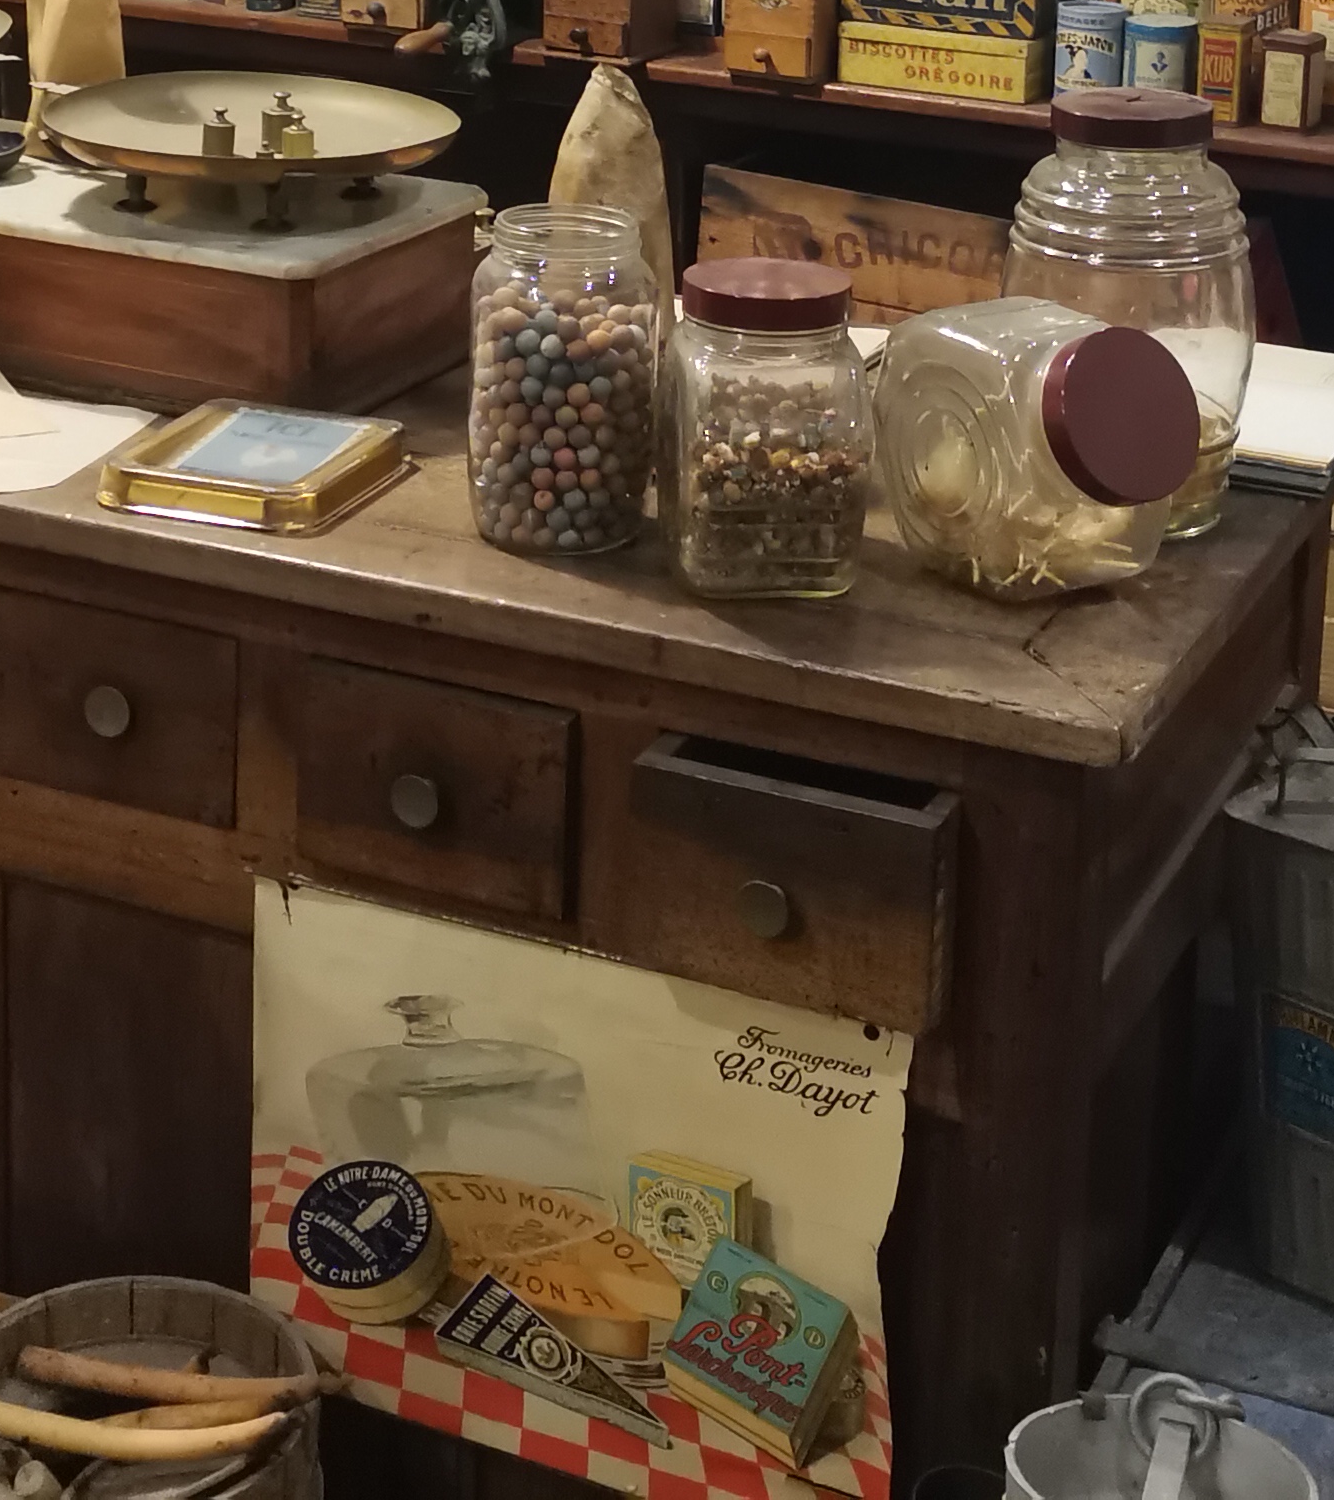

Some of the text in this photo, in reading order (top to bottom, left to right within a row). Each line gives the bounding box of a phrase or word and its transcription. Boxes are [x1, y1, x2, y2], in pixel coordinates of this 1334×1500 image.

[848, 39, 955, 65] BISCOTTES
[1204, 54, 1233, 84] KUB
[904, 63, 1014, 92] GRÉGOIRE
[736, 1025, 873, 1081] Fromageries
[713, 1049, 881, 1117] Ch. Dayot
[322, 1179, 338, 1193] LE
[297, 1209, 382, 1284] DOUBLE CRÈME
[463, 1180, 650, 1277] DU MONT DOL
